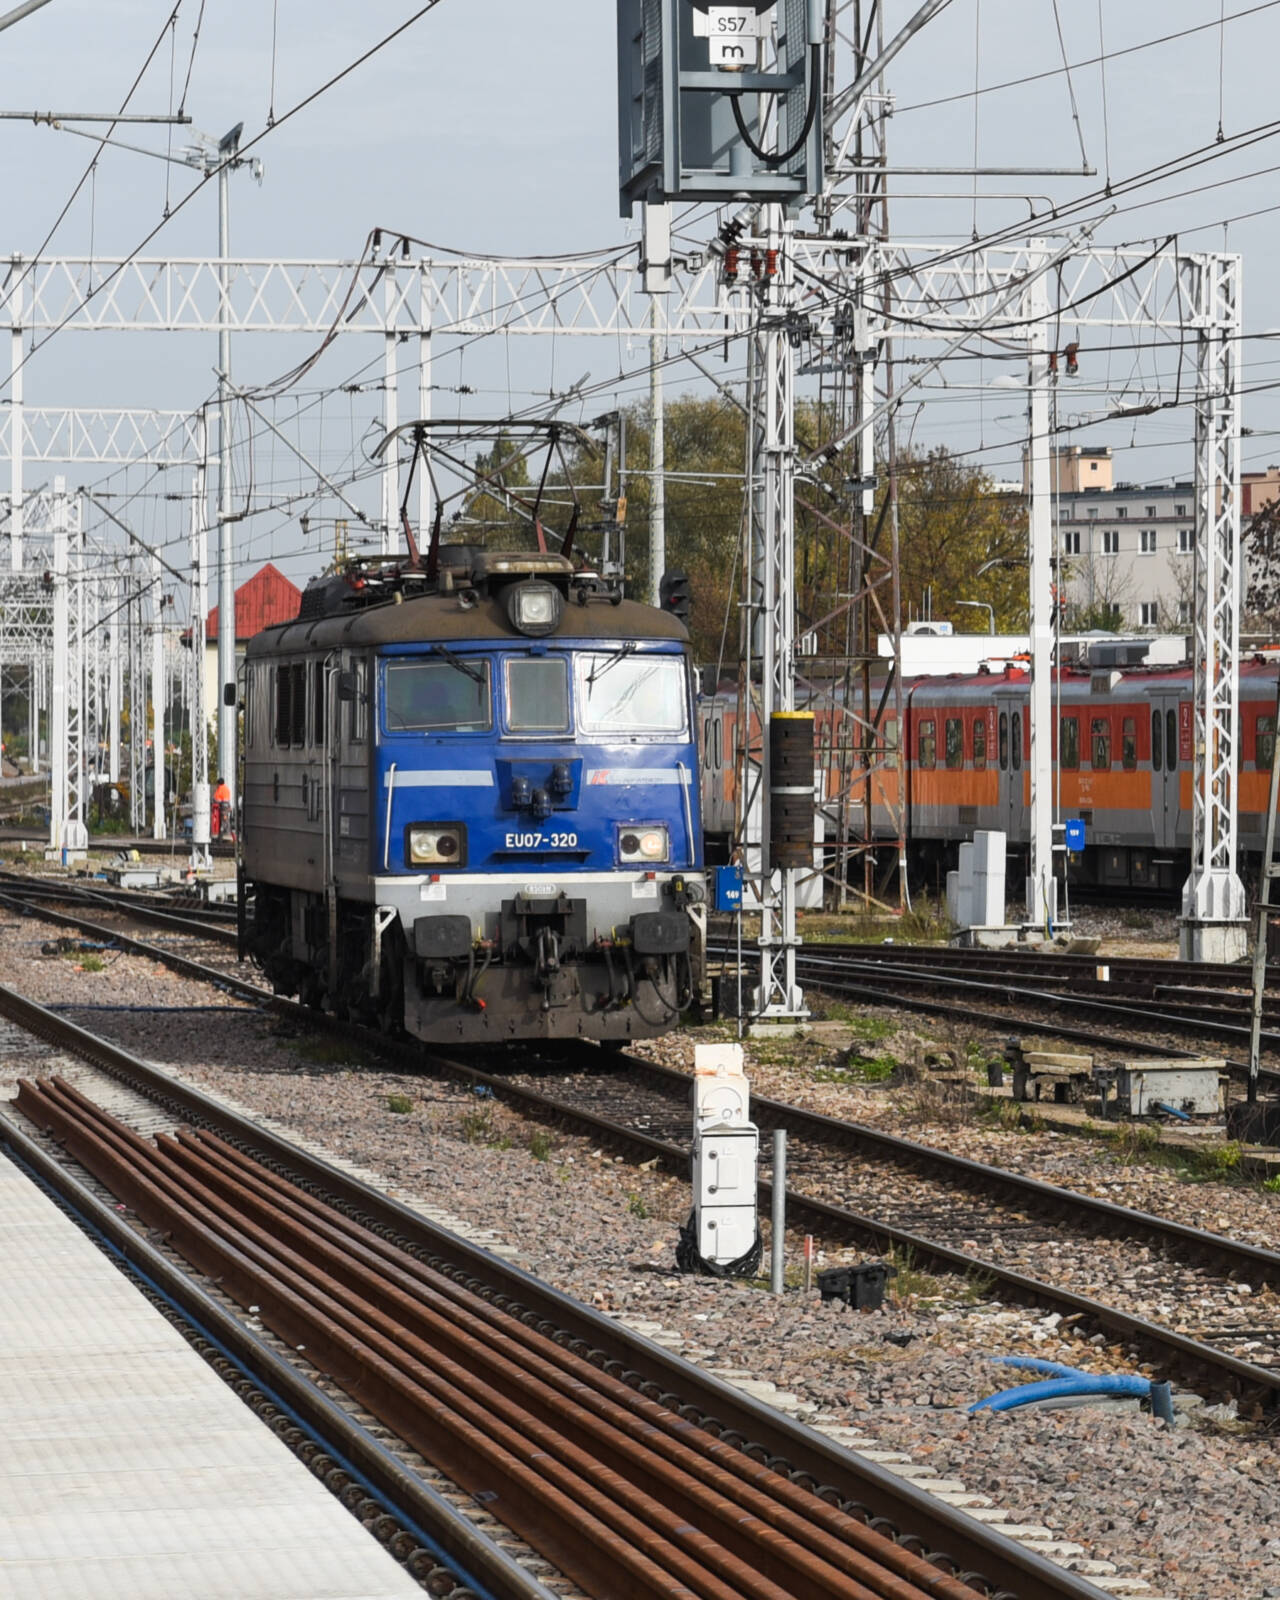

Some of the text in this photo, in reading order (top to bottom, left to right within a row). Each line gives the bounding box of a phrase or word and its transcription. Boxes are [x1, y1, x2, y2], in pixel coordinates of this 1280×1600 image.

[717, 17, 747, 33] S57
[722, 45, 745, 58] m
[505, 833, 578, 848] EU07-320
